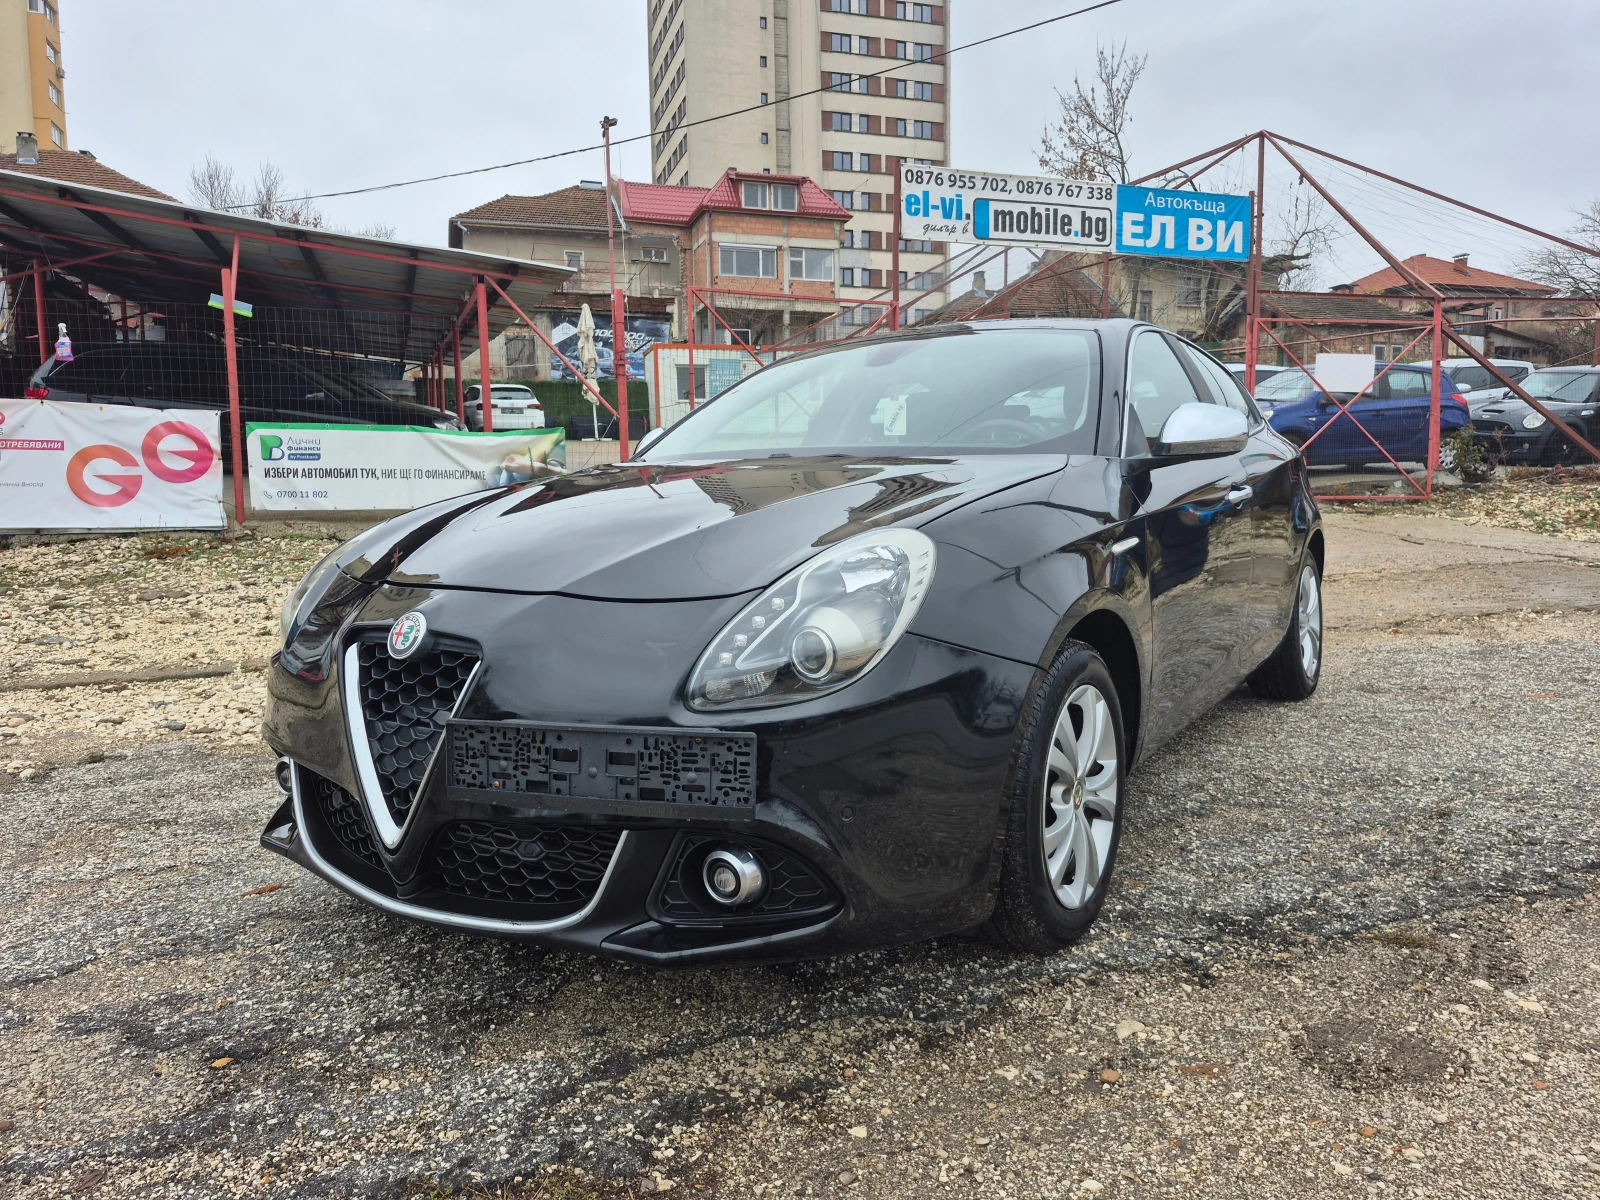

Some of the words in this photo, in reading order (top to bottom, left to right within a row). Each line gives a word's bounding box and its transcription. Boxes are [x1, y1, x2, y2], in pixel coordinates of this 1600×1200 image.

[904, 169, 944, 186] 0876
[948, 174, 976, 190] 955
[980, 177, 1012, 195] 702,
[1016, 180, 1053, 196] 0876
[1056, 183, 1083, 199] 767
[1086, 187, 1112, 201] 338
[1144, 191, 1225, 215] Автокъща
[993, 206, 1107, 243] mobile.bg
[1122, 211, 1175, 249] ЕЛ
[1187, 217, 1243, 254] ВИ
[287, 436, 321, 446] Лични
[264, 467, 299, 479] ИЗБЕРИ
[301, 467, 358, 479] АВТОМОБИЛ
[360, 468, 379, 481] ТУК,
[381, 468, 398, 479] НИЕ
[399, 468, 412, 480] ЩЕ
[413, 468, 423, 480] ГО
[424, 469, 487, 481] ФИНАНСИРАМЕ
[276, 490, 298, 498] 0700
